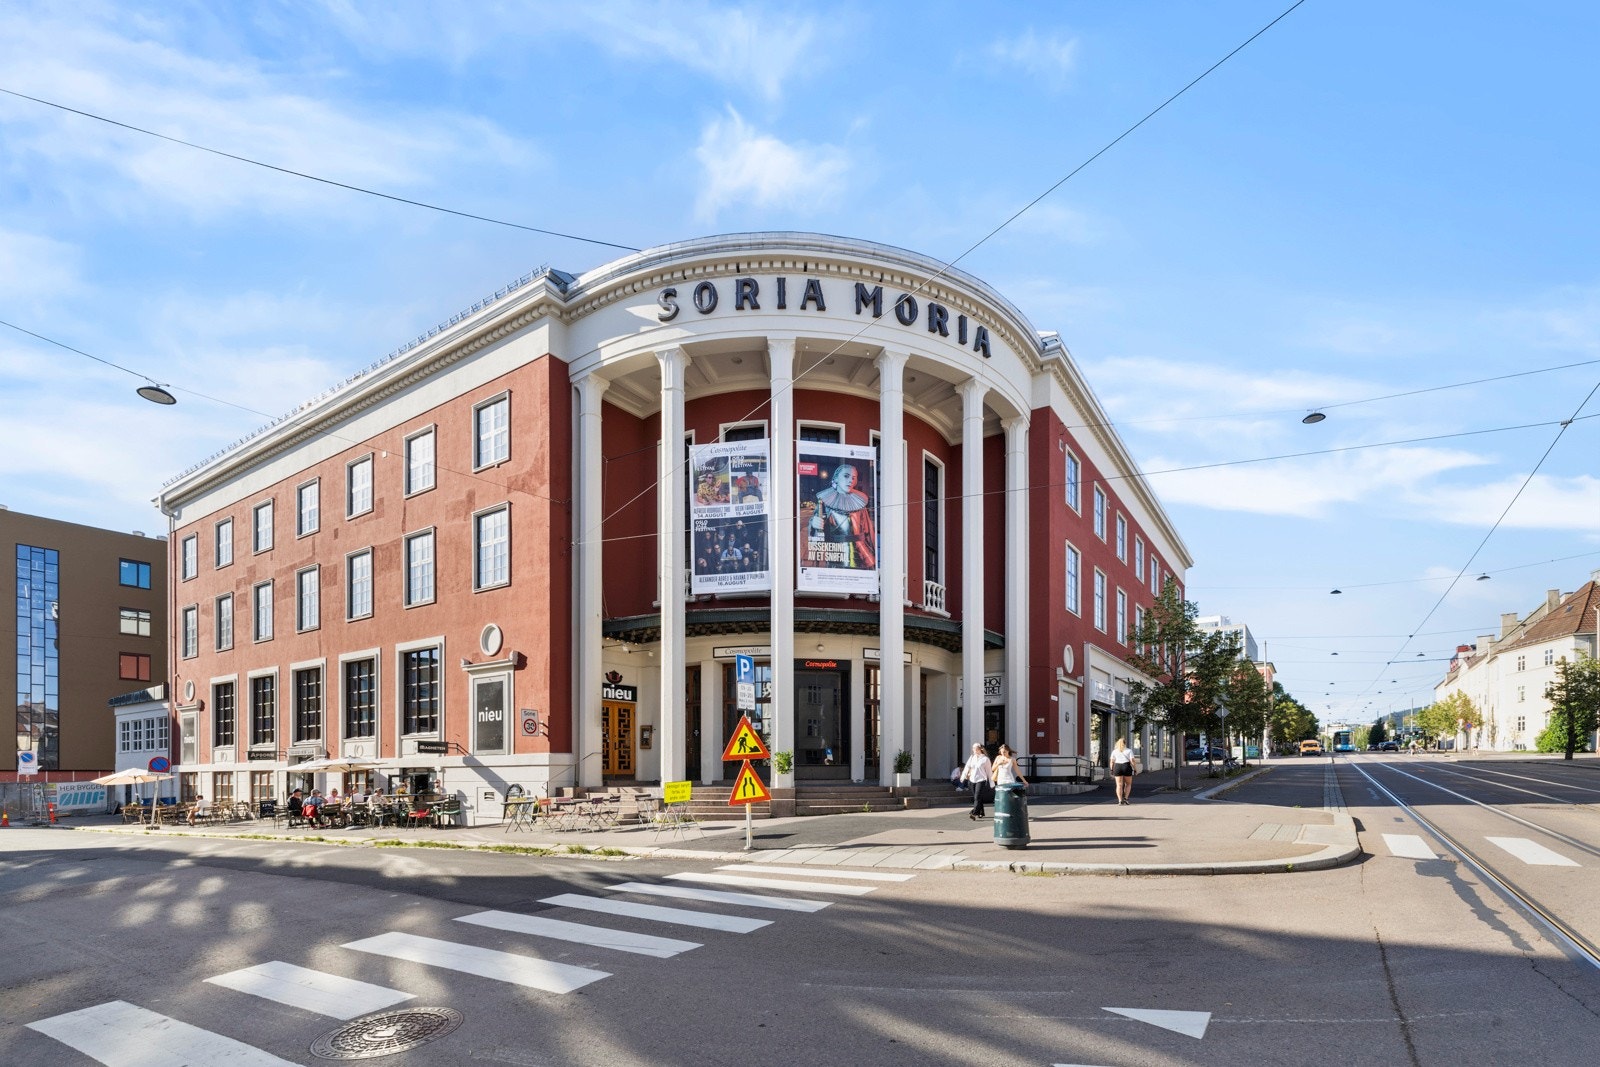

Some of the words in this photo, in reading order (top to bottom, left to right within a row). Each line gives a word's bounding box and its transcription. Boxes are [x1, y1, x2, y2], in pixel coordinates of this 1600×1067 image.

[657, 277, 826, 322] SORIA
[854, 282, 992, 359] MORIA
[710, 445, 747, 454] Cosmopolite
[808, 551, 815, 560] AV
[817, 551, 825, 561] ET
[741, 658, 750, 680] P
[805, 660, 837, 669] Cosmopolite
[603, 684, 632, 701] nieu
[478, 706, 502, 722] nieu
[526, 722, 535, 731] 30
